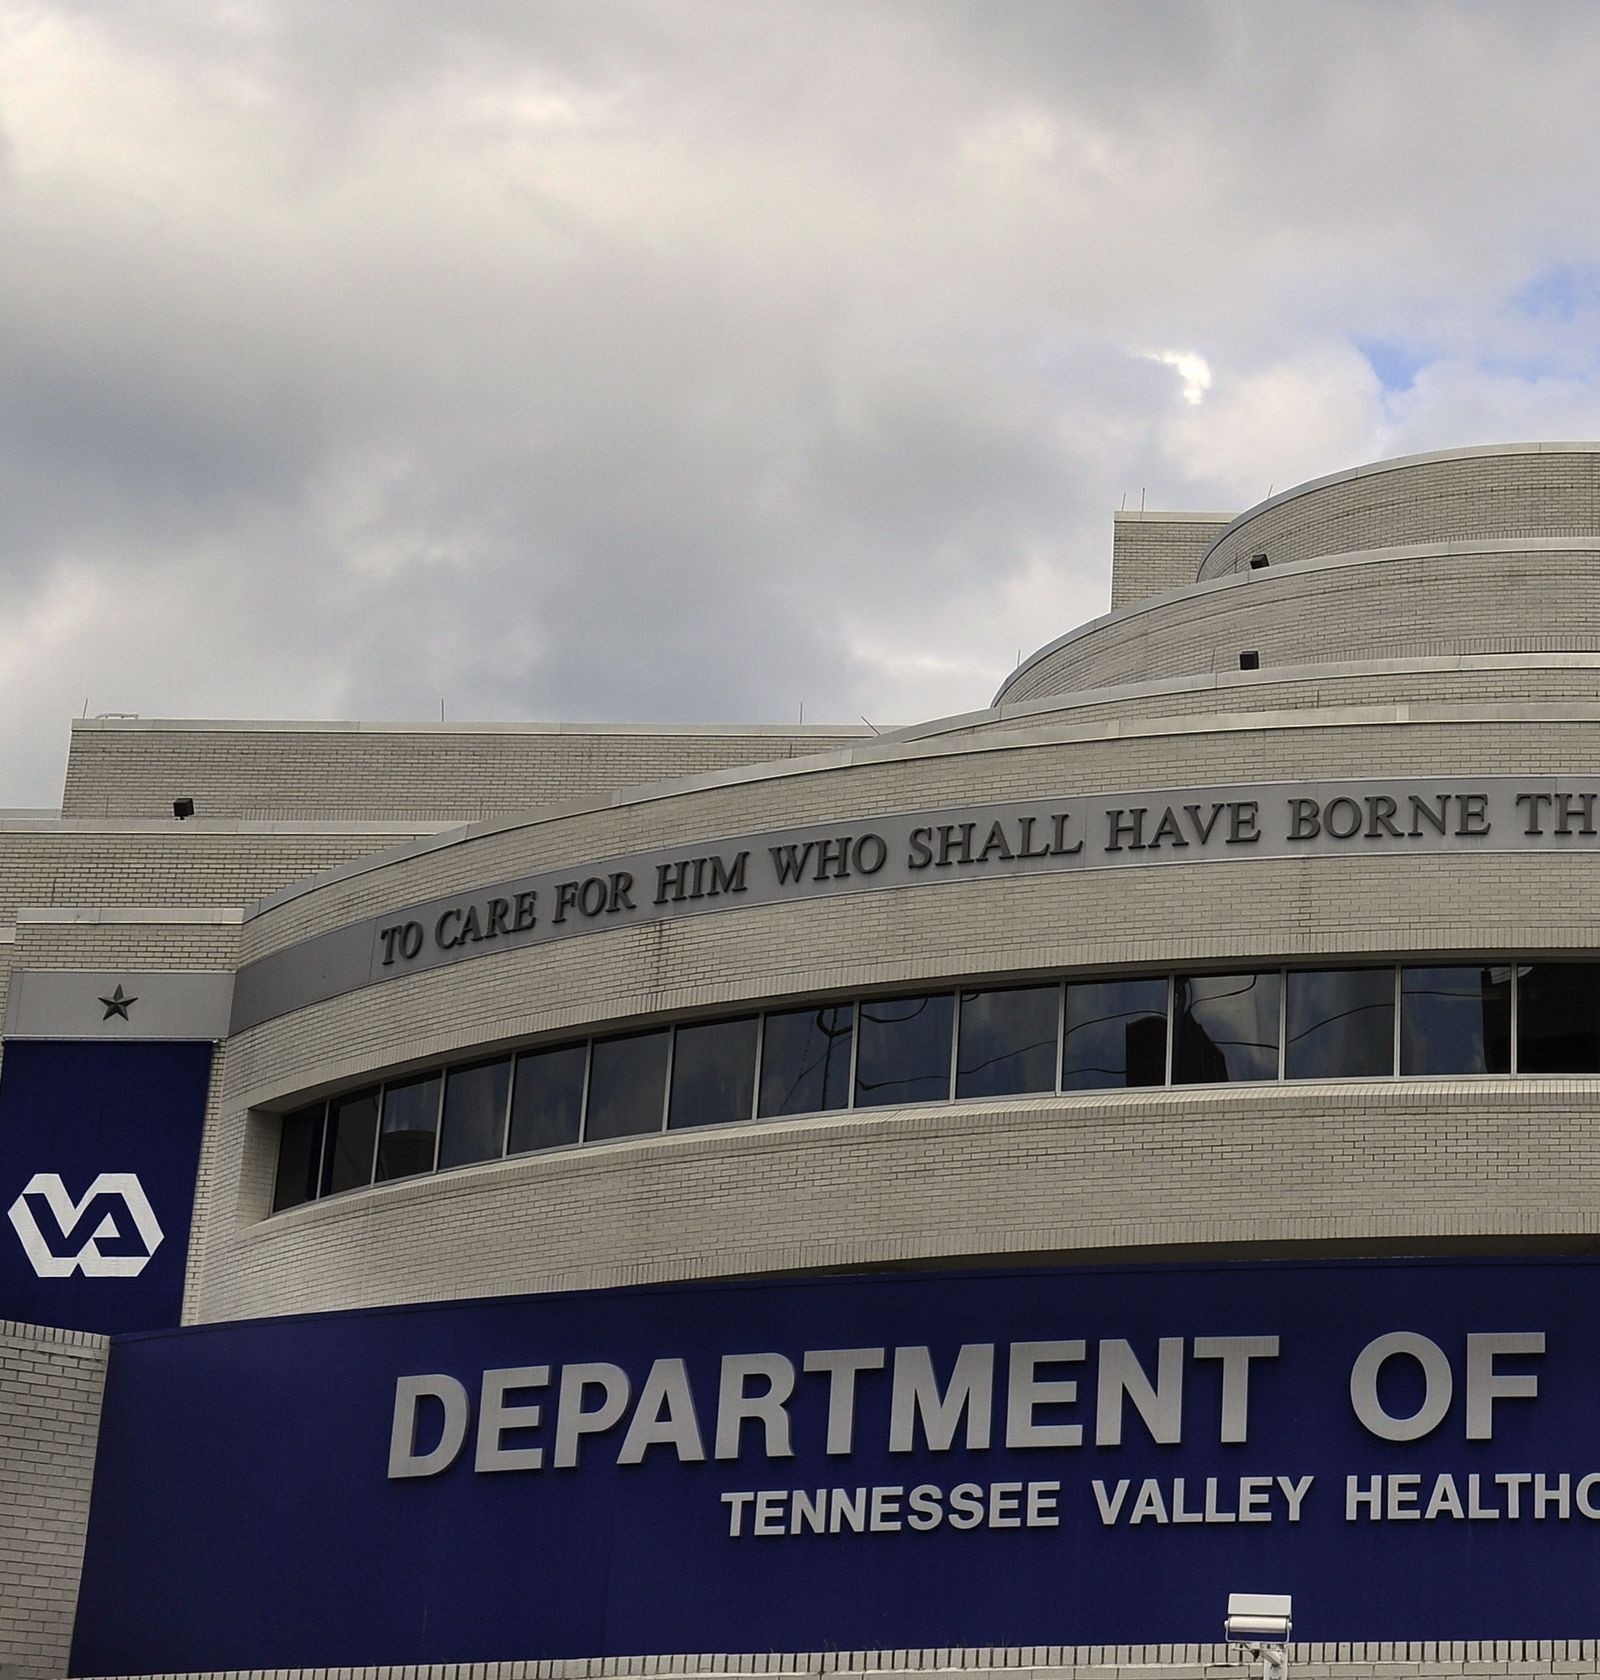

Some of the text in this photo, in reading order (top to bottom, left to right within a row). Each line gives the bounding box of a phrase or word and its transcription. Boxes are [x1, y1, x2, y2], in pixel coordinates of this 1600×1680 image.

[380, 923, 423, 965] TO
[435, 897, 538, 950] CARE
[551, 870, 635, 924] FOR
[653, 850, 750, 905] HIM
[768, 832, 887, 885] WHO
[907, 813, 1084, 869] SHALL
[1105, 800, 1261, 852] HAVE
[1287, 793, 1492, 840] BORNE
[7, 1173, 165, 1278] VA
[387, 1335, 1280, 1479] DEPARTMENT
[1350, 1331, 1547, 1443] OF
[720, 1480, 1061, 1538] TENNESSEE
[1091, 1475, 1315, 1525] VALLEY
